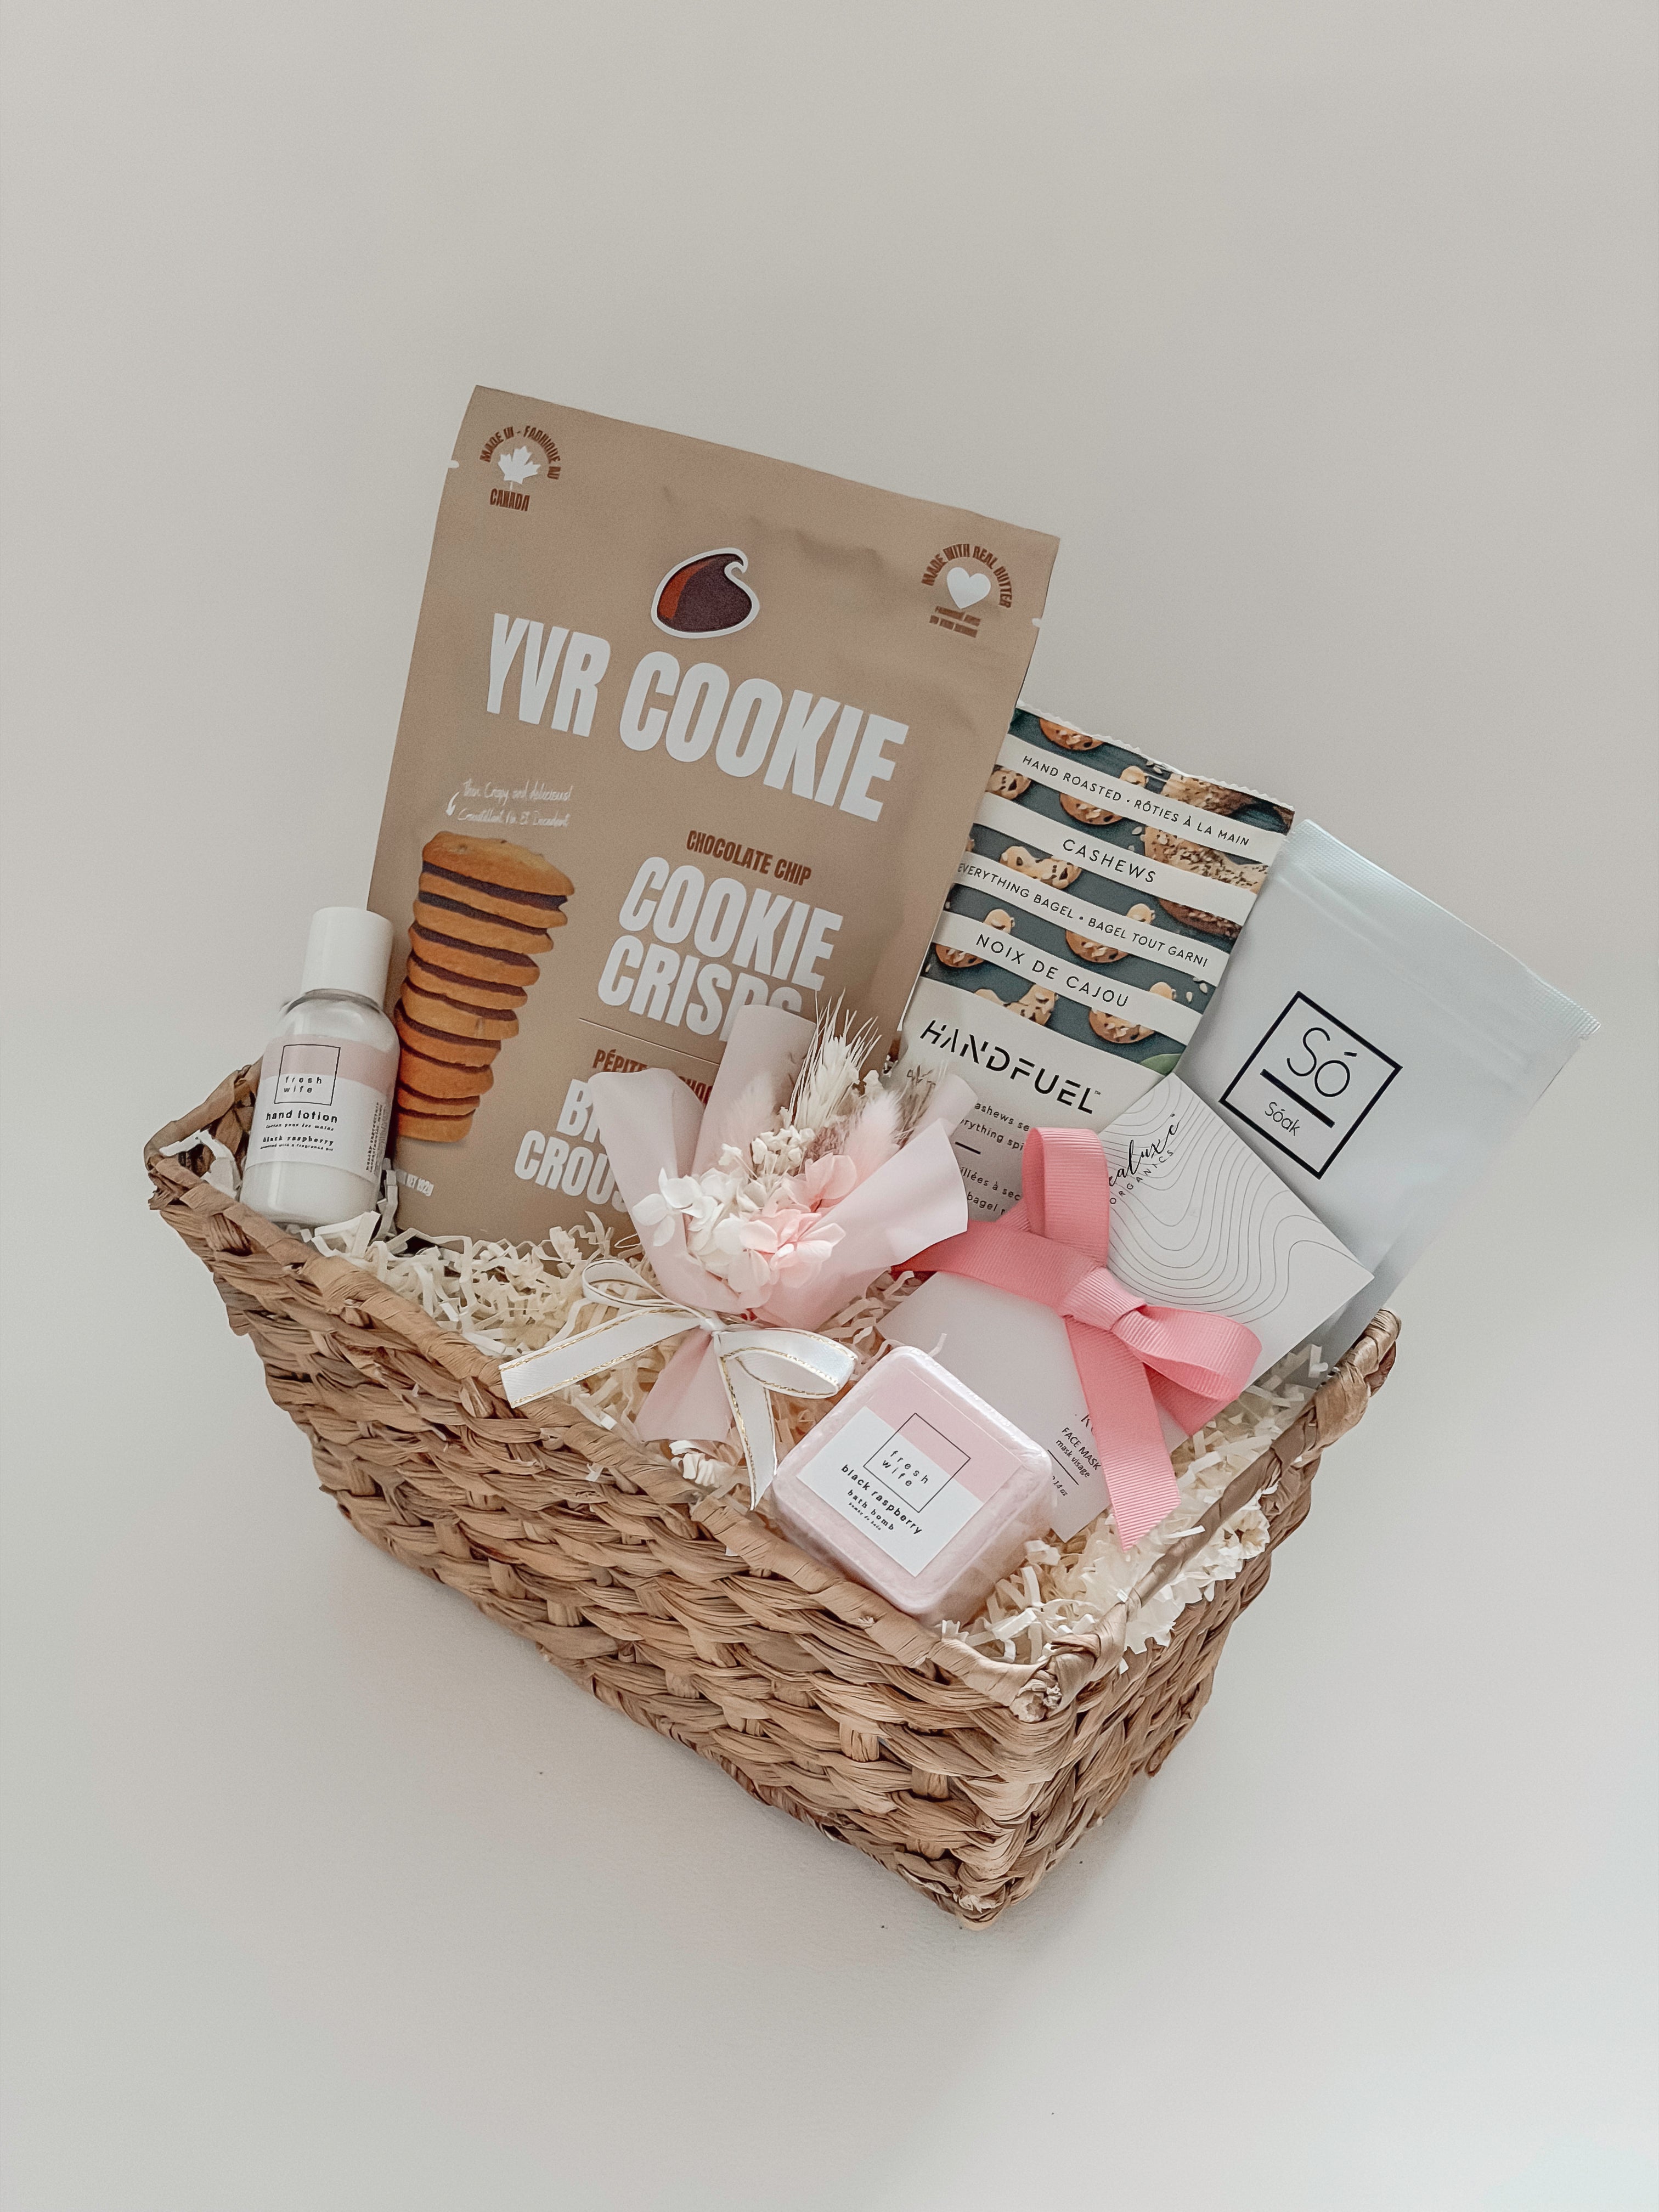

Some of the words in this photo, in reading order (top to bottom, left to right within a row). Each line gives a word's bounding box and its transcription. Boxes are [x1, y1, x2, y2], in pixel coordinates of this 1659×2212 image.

[479, 431, 504, 462] MADE
[489, 488, 531, 511] CANADA
[921, 553, 949, 586] MADE
[943, 543, 970, 561] WITH
[972, 545, 998, 570] REAL
[992, 566, 1012, 608] BUTTER
[487, 612, 611, 737] YVR
[619, 651, 909, 822] COOKIE
[1022, 755, 1059, 777] HAND
[1063, 772, 1122, 802] ROASTED
[1133, 799, 1180, 822] RÔTIES
[1183, 815, 1192, 827] À
[1197, 823, 1212, 836] LA
[1217, 831, 1250, 847] MAIN
[686, 830, 773, 874] CHOCOLATE
[774, 858, 812, 886] CHIP
[1063, 839, 1156, 883] CASHEWS
[619, 856, 843, 991] COOKIE
[957, 862, 1030, 899] EVERYTHING
[1033, 893, 1073, 919] BAGEL
[1087, 917, 1126, 940] BAGEL
[1132, 933, 1167, 952] TOUT
[1167, 945, 1208, 968] GARNI
[975, 933, 1025, 965] NOIX
[1032, 960, 1058, 980] DE
[1066, 975, 1129, 1007] CAJOU
[285, 1076, 322, 1085] fresh
[1286, 1026, 1357, 1098] Só
[284, 1085, 313, 1093] wife
[266, 1109, 293, 1121] hand
[297, 1109, 337, 1124] lotion
[1265, 1101, 1301, 1136] Sóak
[287, 1135, 334, 1147] raspberry
[992, 1181, 998, 1191] à
[1109, 1150, 1174, 1205] ORGANICS
[967, 1191, 998, 1212] bagel
[890, 1450, 929, 1484] fresh
[1056, 1439, 1073, 1458] mask
[1071, 1455, 1091, 1478] visage
[1062, 1427, 1082, 1448] FACE
[1078, 1446, 1101, 1471] MASK
[882, 1460, 912, 1487] wife
[841, 1464, 871, 1491] black
[871, 1490, 923, 1534] raspberry
[848, 1489, 867, 1509] bath
[870, 1509, 894, 1531] bomb
